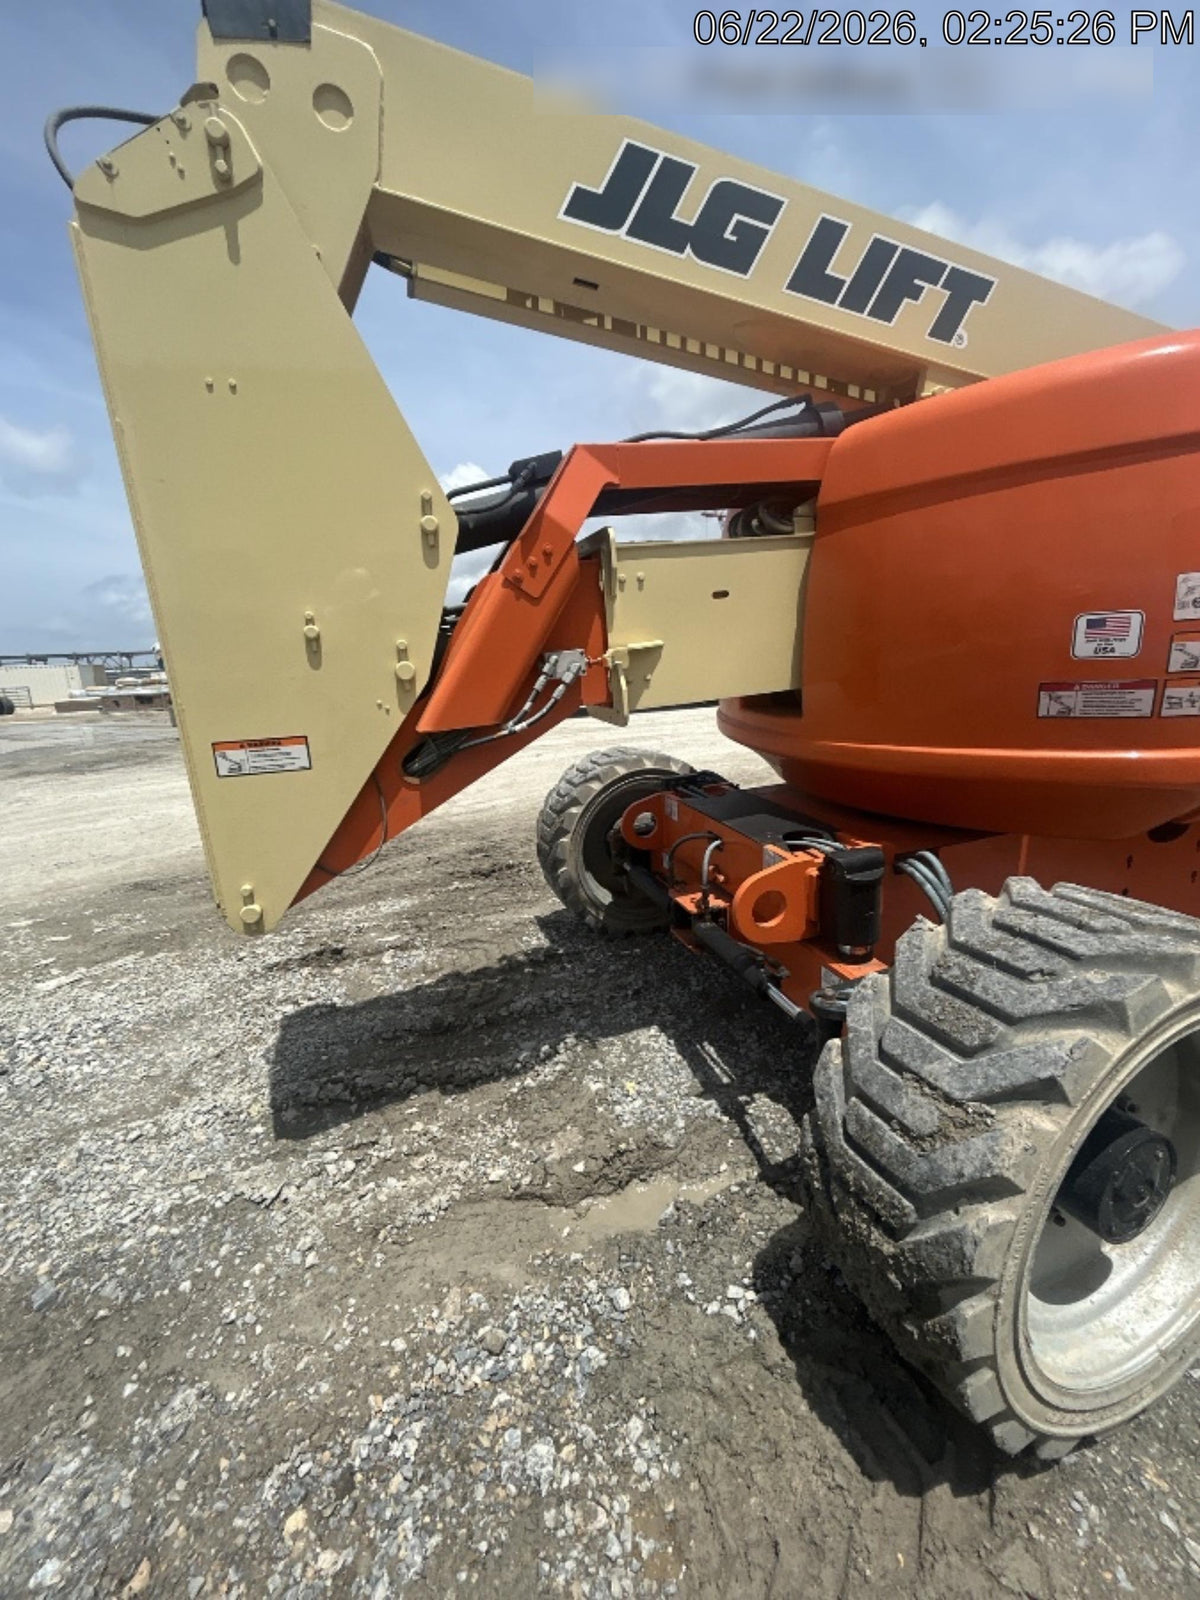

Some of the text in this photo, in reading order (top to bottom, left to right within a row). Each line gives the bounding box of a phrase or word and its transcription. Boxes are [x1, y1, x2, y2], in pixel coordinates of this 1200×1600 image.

[557, 137, 998, 346] JLG LIFT
[1093, 646, 1116, 655] USA
